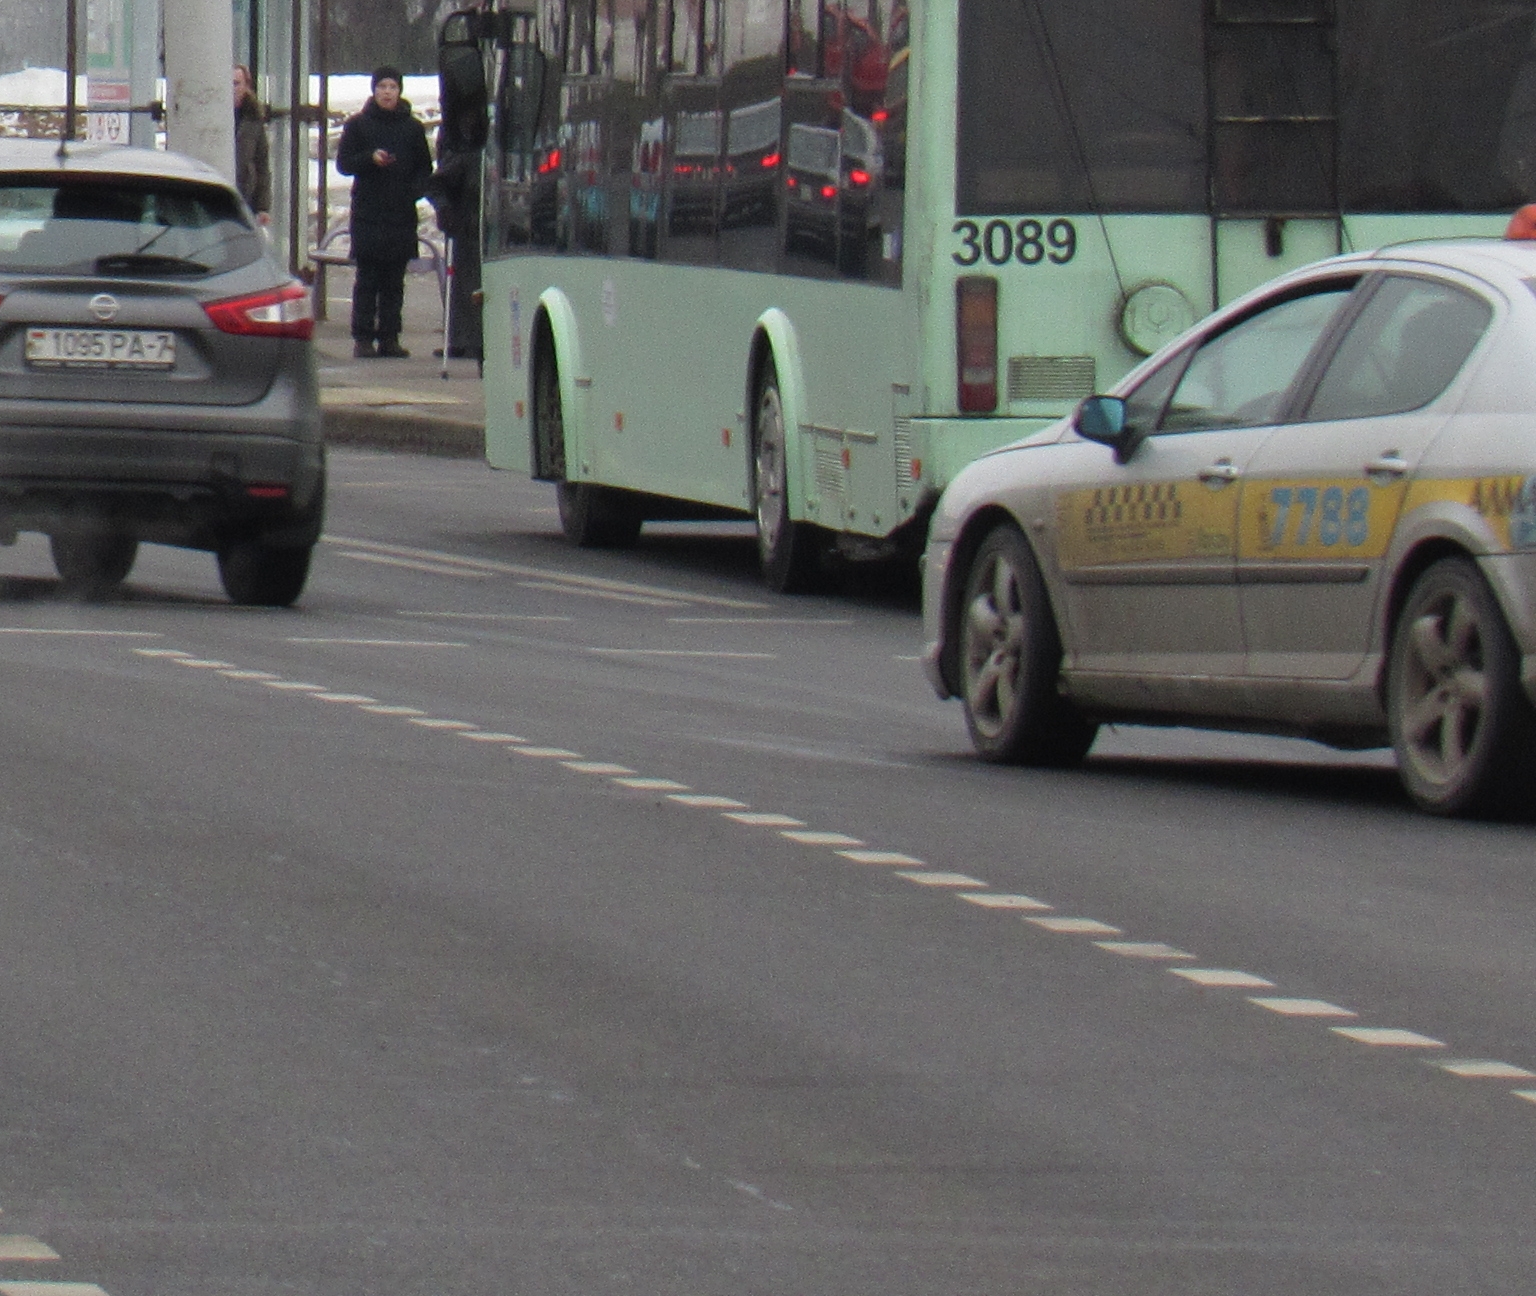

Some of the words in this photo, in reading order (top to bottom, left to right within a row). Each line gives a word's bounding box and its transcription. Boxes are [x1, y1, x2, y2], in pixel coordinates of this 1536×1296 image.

[950, 217, 1078, 267] 3089
[52, 331, 106, 357] 1095
[110, 332, 171, 359] PA-7
[1270, 484, 1370, 547] 7788
